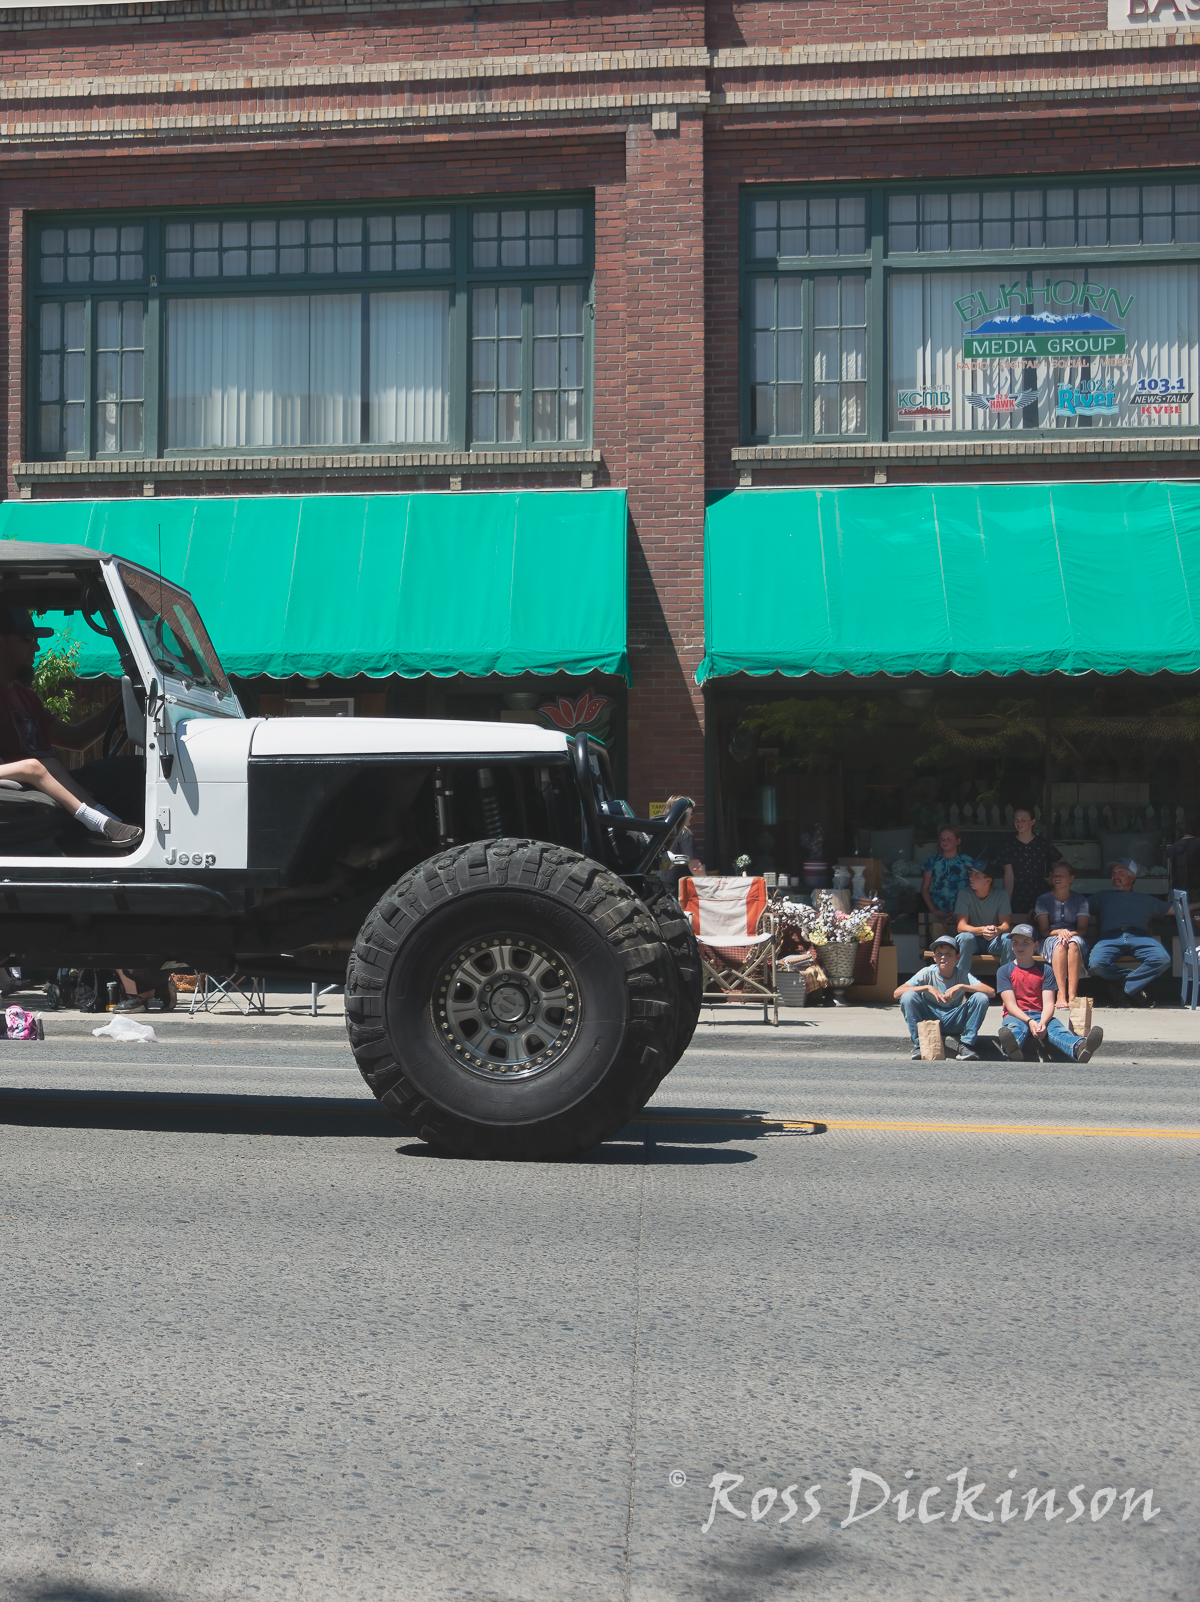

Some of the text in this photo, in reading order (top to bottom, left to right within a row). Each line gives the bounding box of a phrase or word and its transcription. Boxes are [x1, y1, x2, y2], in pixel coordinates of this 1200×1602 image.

[953, 279, 1135, 323] ELKHORN
[972, 337, 1116, 355] MEDIA GROUP
[956, 357, 1134, 371] RADIO DIGITAL SOCIAL VIDEO
[1081, 379, 1115, 393] 102.3
[1138, 378, 1185, 394] 103.1
[898, 391, 951, 407] KCMB
[990, 399, 1015, 409] HAWK
[1058, 389, 1116, 414] River
[1141, 406, 1182, 415] KVBL
[165, 848, 216, 868] Jeep
